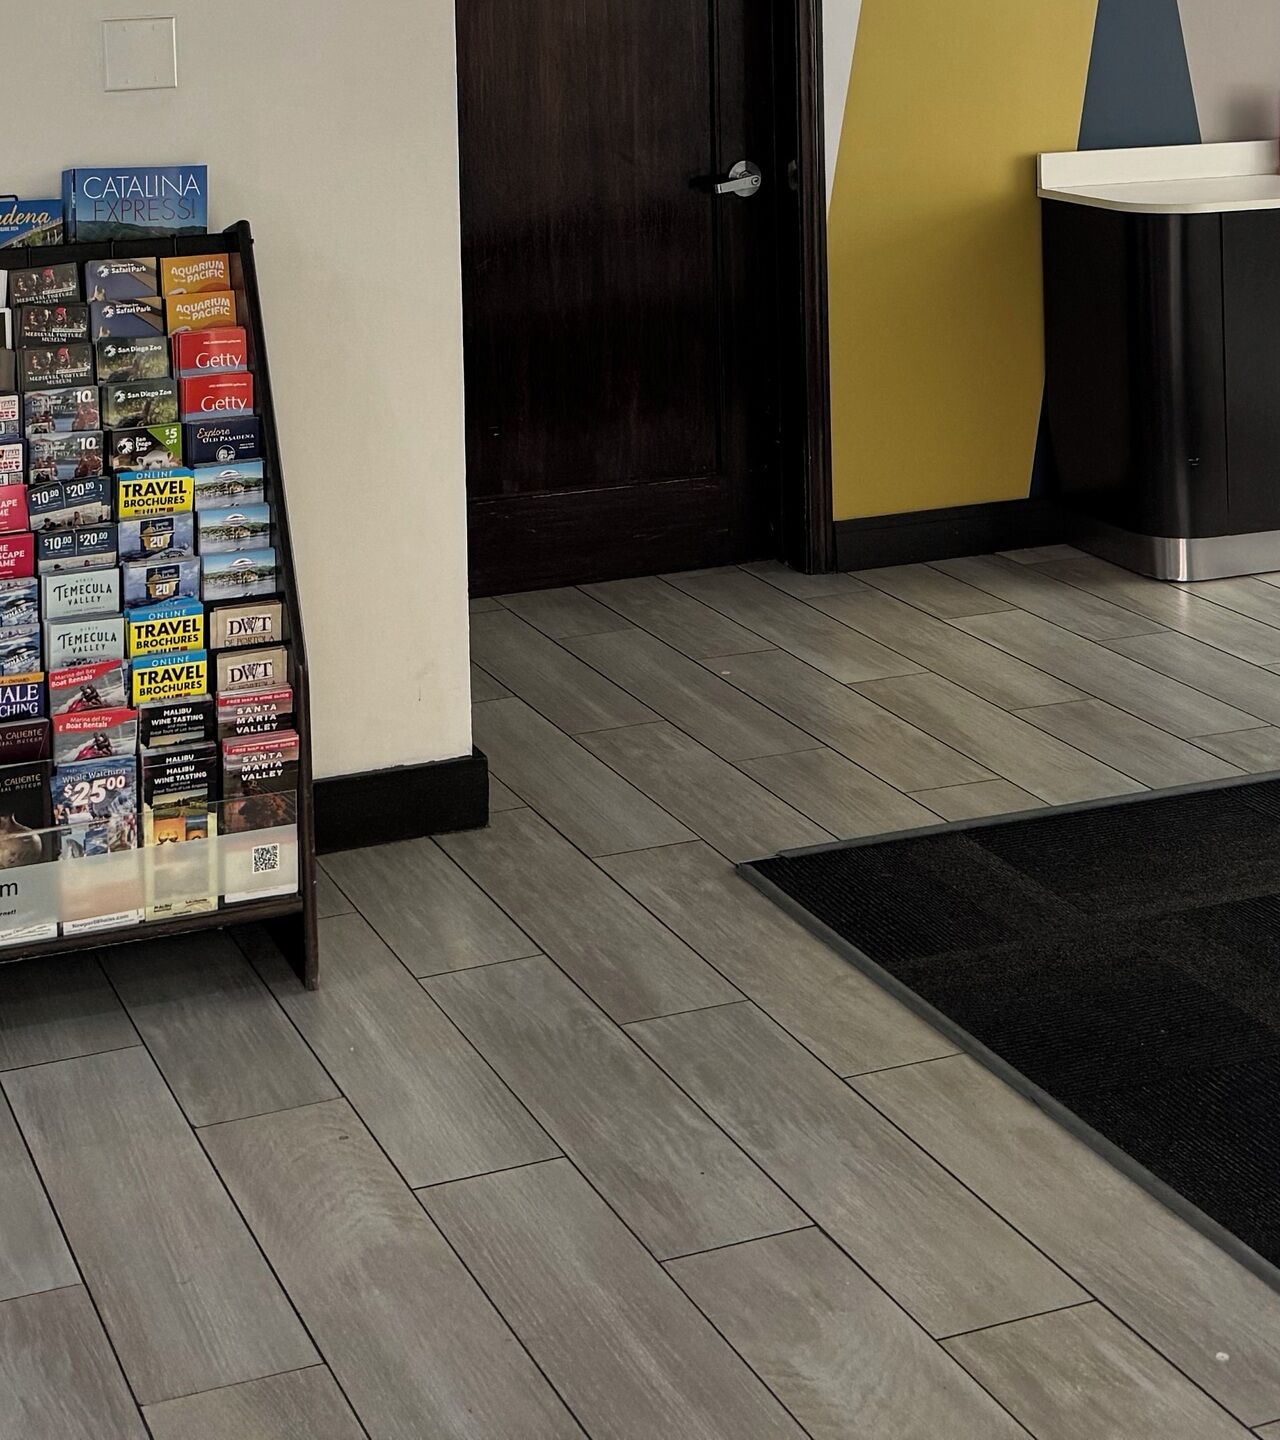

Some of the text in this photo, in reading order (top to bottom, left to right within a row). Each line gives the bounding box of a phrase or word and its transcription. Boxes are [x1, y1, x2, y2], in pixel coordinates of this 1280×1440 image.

[83, 174, 201, 199] CATALINA
[93, 198, 196, 222] EXPRESS!
[171, 260, 225, 276] AQUARIUM
[186, 269, 224, 284] PACIFIC
[196, 352, 242, 369] Getty
[196, 427, 231, 439] Explore
[202, 433, 255, 444] OLD PASADENA
[122, 478, 187, 498] TRAVEL
[123, 495, 185, 509] BROCHURES
[53, 583, 112, 602] TEMECULA
[67, 596, 101, 606] VALLEY
[148, 609, 186, 620] ONLINE
[134, 618, 200, 639] TRAVEL
[228, 616, 271, 636] DWT
[136, 634, 199, 650] BROCHURES
[151, 656, 190, 667] ONLINE
[137, 665, 204, 686] TRAVEL
[228, 661, 273, 684] DWT
[139, 680, 202, 696] BROCHURES
[163, 707, 192, 717] MALIBU
[236, 703, 277, 716] SANTA
[151, 712, 204, 726] WINE TASTING
[236, 714, 277, 725] MARIA
[235, 722, 279, 735] VALLEY
[4, 773, 41, 786] CALIENTE
